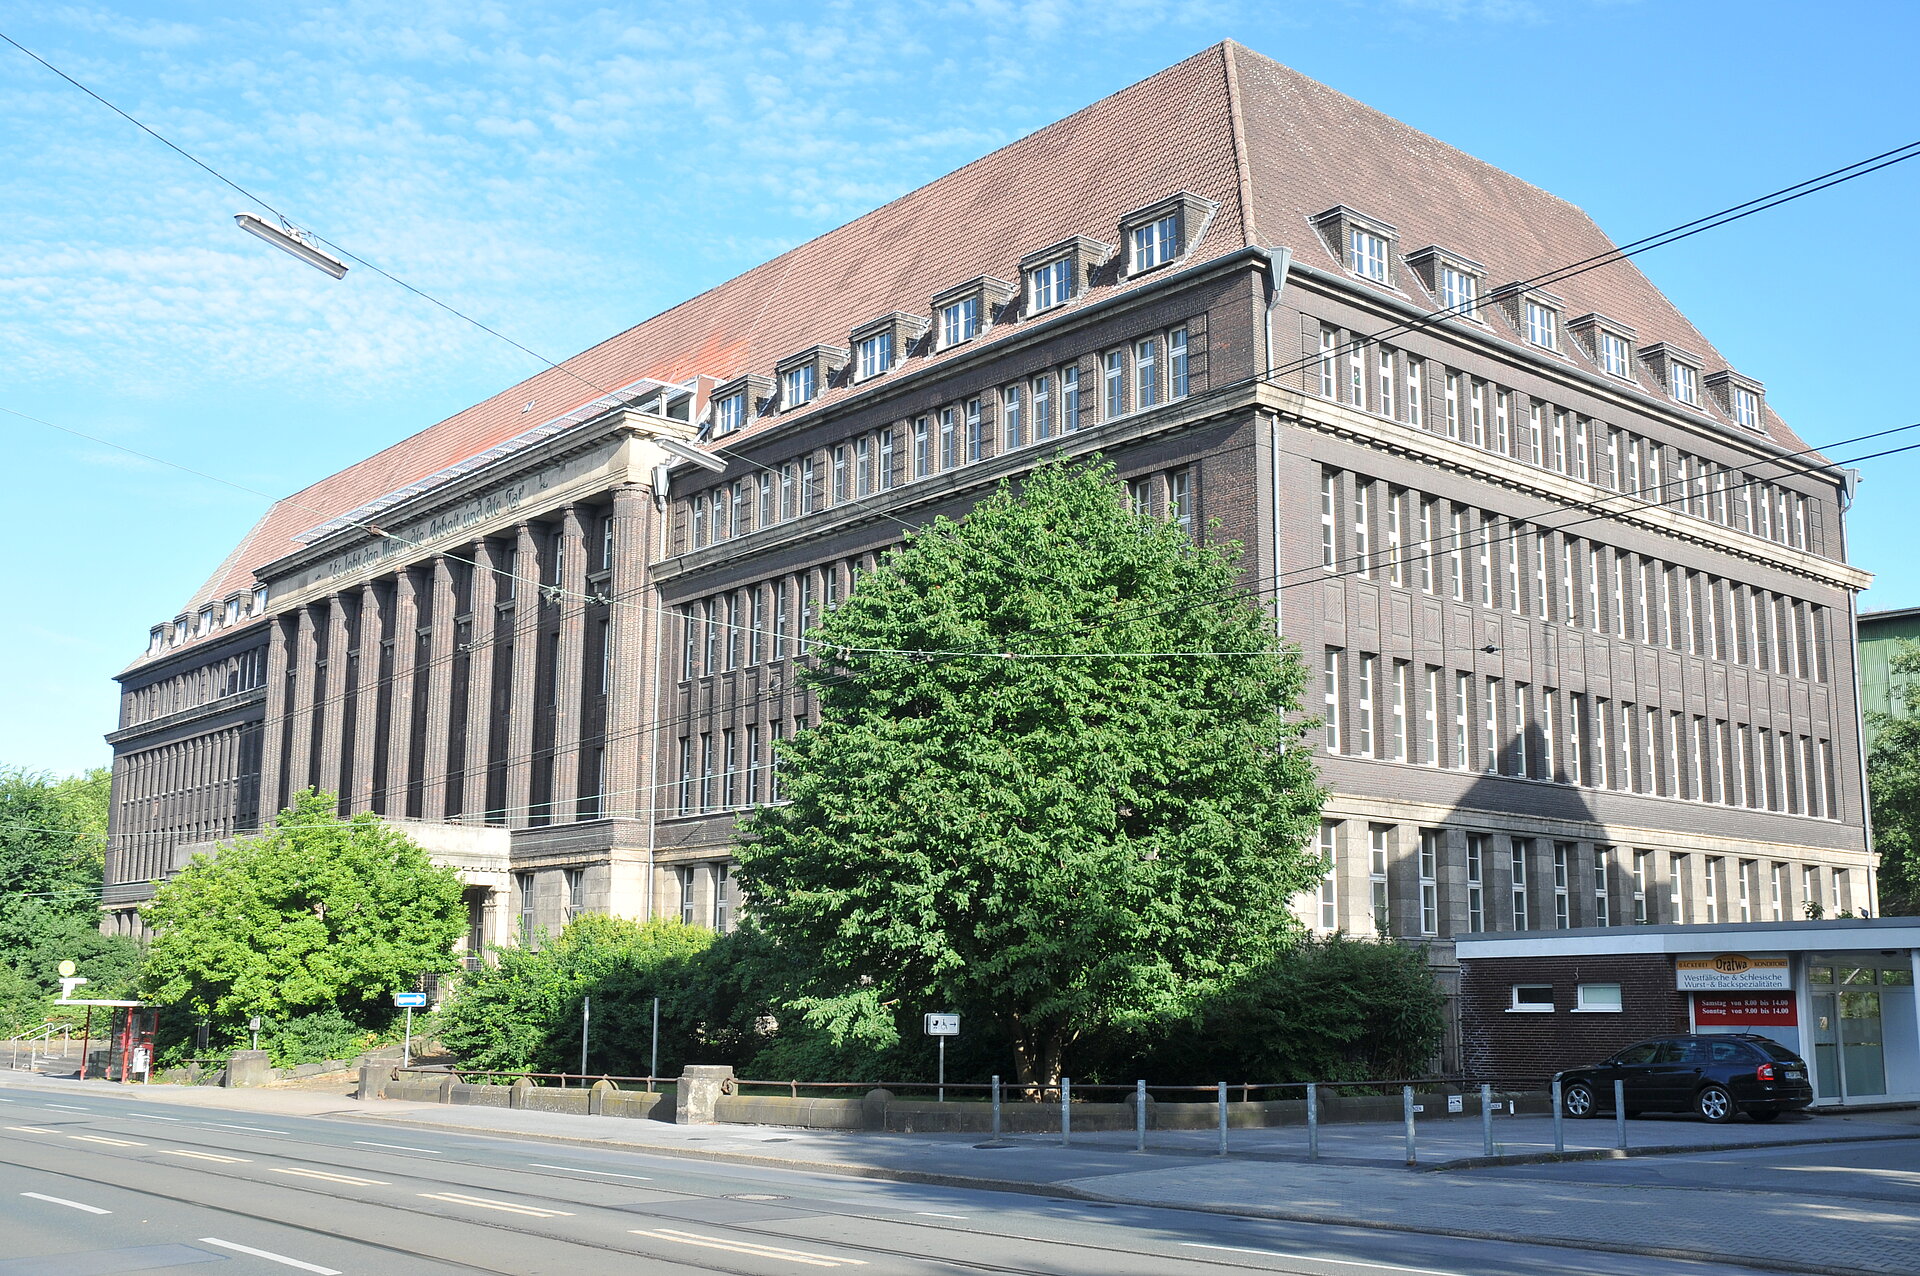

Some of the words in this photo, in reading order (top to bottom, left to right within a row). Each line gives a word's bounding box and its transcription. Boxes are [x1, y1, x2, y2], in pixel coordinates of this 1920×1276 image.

[429, 513, 459, 540] Arbeit
[463, 502, 483, 529] und
[485, 497, 501, 521] die
[1718, 981, 1783, 989] Backspezialitäten
